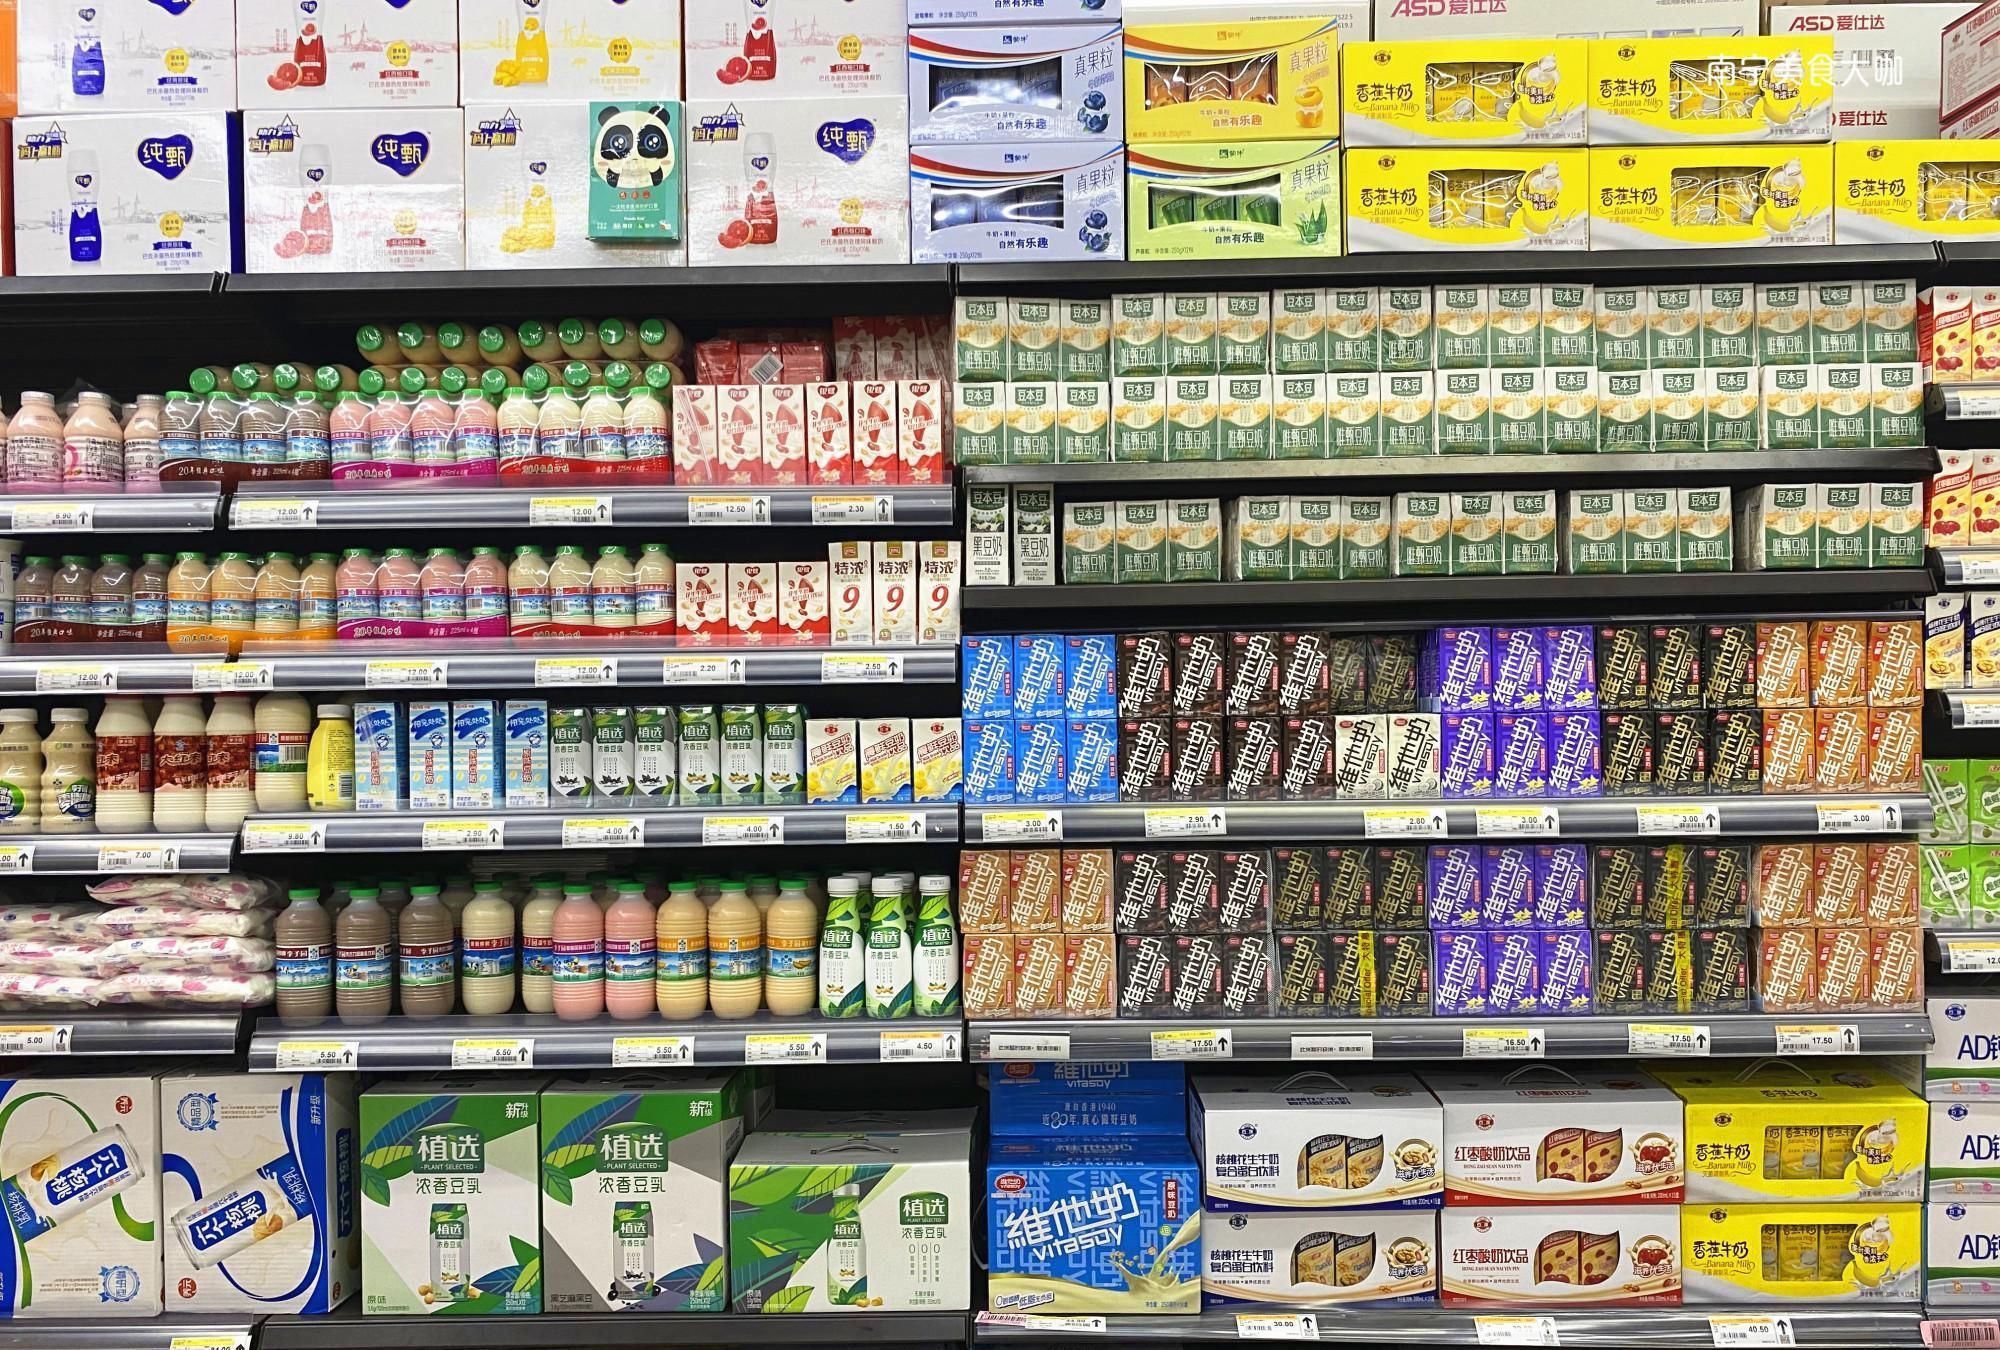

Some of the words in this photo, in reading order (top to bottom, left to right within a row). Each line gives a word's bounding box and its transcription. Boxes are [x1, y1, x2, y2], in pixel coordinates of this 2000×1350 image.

[1390, 0, 1445, 17] ASD
[1789, 16, 1833, 31] ASD
[1837, 15, 1885, 30] 爱仕达
[1074, 51, 1114, 79] 真果粒
[1288, 45, 1328, 73] 真果粒
[1356, 84, 1413, 101] 香蕉牛奶
[1600, 79, 1657, 97] 香蕉牛奶
[997, 119, 1047, 130] 自然有乐趣
[1212, 115, 1262, 127] 自然有乐趣
[1839, 111, 1887, 126] 爱仕达
[821, 126, 867, 152] 纯甄
[142, 144, 189, 170] 纯甄
[374, 138, 426, 168] 纯甄
[1076, 168, 1115, 196] 真果粒
[1291, 163, 1330, 192] 真果粒
[1849, 180, 1905, 197] 香蕉牛奶
[1361, 189, 1417, 206] 香蕉牛奶
[999, 237, 1049, 249] 自然有乐趣
[1215, 232, 1265, 244] 自然有乐趣
[1660, 293, 1687, 305] 豆本豆
[1876, 286, 1903, 298] 豆本豆
[1286, 295, 1313, 308] 豆本豆
[968, 304, 995, 317] 豆本豆
[1504, 375, 1531, 388] 豆本豆
[1830, 371, 1857, 384] 豆本豆
[966, 390, 992, 402] 豆本豆
[1179, 383, 1207, 395] 豆本豆
[974, 492, 1001, 505] 豆本豆
[1020, 494, 1047, 507] 豆本豆
[1516, 498, 1543, 511] 豆本豆
[1776, 490, 1804, 503] 豆本豆
[1128, 507, 1154, 519] 豆本豆
[973, 537, 1002, 557] 黑豆奶
[1021, 538, 1049, 558] 黑豆奶
[835, 561, 863, 575] 特浓
[879, 561, 908, 575] 特浓
[925, 561, 953, 574] 特浓
[843, 587, 860, 612] 9
[887, 586, 904, 612] 9
[932, 586, 949, 611] 9
[1464, 647, 1489, 698] vitasoy
[1891, 641, 1919, 692] vitasoy
[985, 656, 1010, 705] vitasoy
[1144, 653, 1169, 703] vitasoy
[1198, 652, 1222, 702] vitasoy
[684, 726, 709, 737] 植选
[769, 725, 794, 736] 植选
[1414, 734, 1438, 783] vitasoy
[983, 869, 1007, 918] vitasoy
[1453, 864, 1478, 914] vitasoy
[870, 932, 899, 944] 植选
[922, 929, 952, 942] 植选
[418, 1134, 479, 1162] 植选
[600, 1133, 664, 1161] 植选
[1454, 1147, 1530, 1161] 红枣酸奶饮品
[1696, 1145, 1750, 1161] 香蕉牛奶
[1216, 1153, 1280, 1165] 核桃花生牛奶
[50, 1148, 122, 1201] 六个核桃
[1216, 1166, 1280, 1177] 复合蛋白饮料
[416, 1177, 482, 1195] 浓香豆乳
[599, 1176, 666, 1194] 浓香豆乳
[903, 1199, 946, 1217] 植选
[1167, 1181, 1177, 1219] 原味豆奶
[194, 1195, 262, 1247] 六个核桃
[1004, 1182, 1140, 1249] 維他奶
[902, 1227, 947, 1239] 浓香豆乳
[1032, 1225, 1123, 1261] vitasoy
[1693, 1241, 1748, 1259] 香蕉牛奶
[1210, 1250, 1273, 1261] 核桃花生牛奶
[1453, 1249, 1528, 1263] 红枣酸奶饮品
[1210, 1262, 1273, 1273] 复合蛋白饮料
